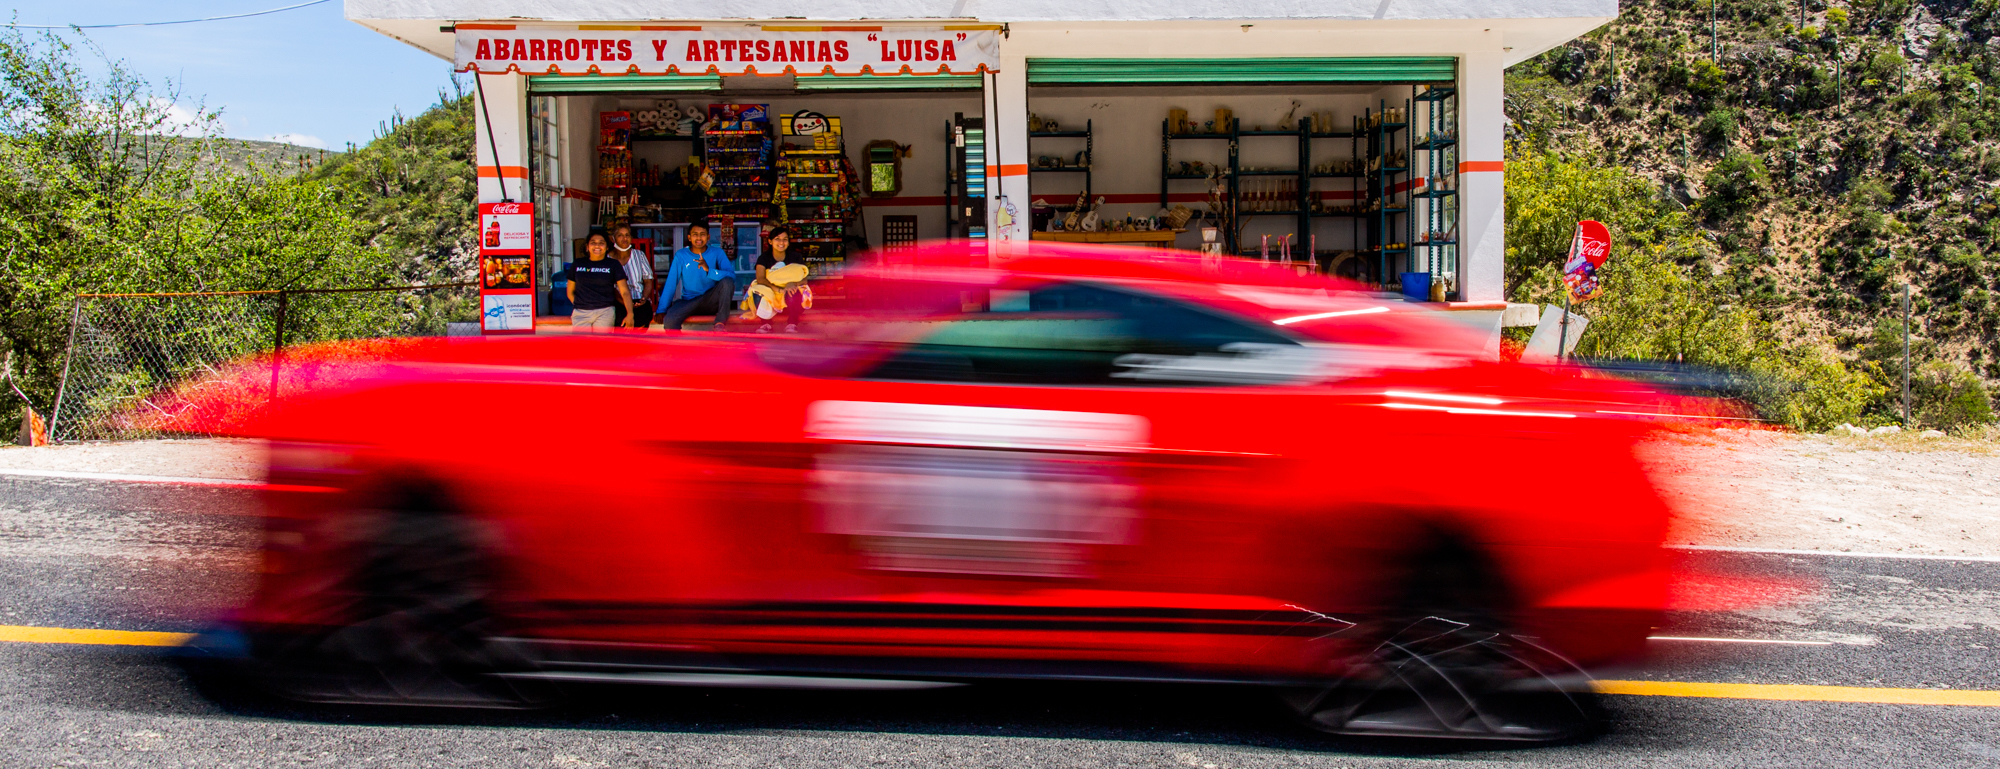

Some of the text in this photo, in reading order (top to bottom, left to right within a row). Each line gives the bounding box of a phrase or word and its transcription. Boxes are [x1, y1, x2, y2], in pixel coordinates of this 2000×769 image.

[475, 39, 632, 61] ABARROTES
[652, 39, 668, 62] Y
[686, 39, 849, 62] ARTESANIAS
